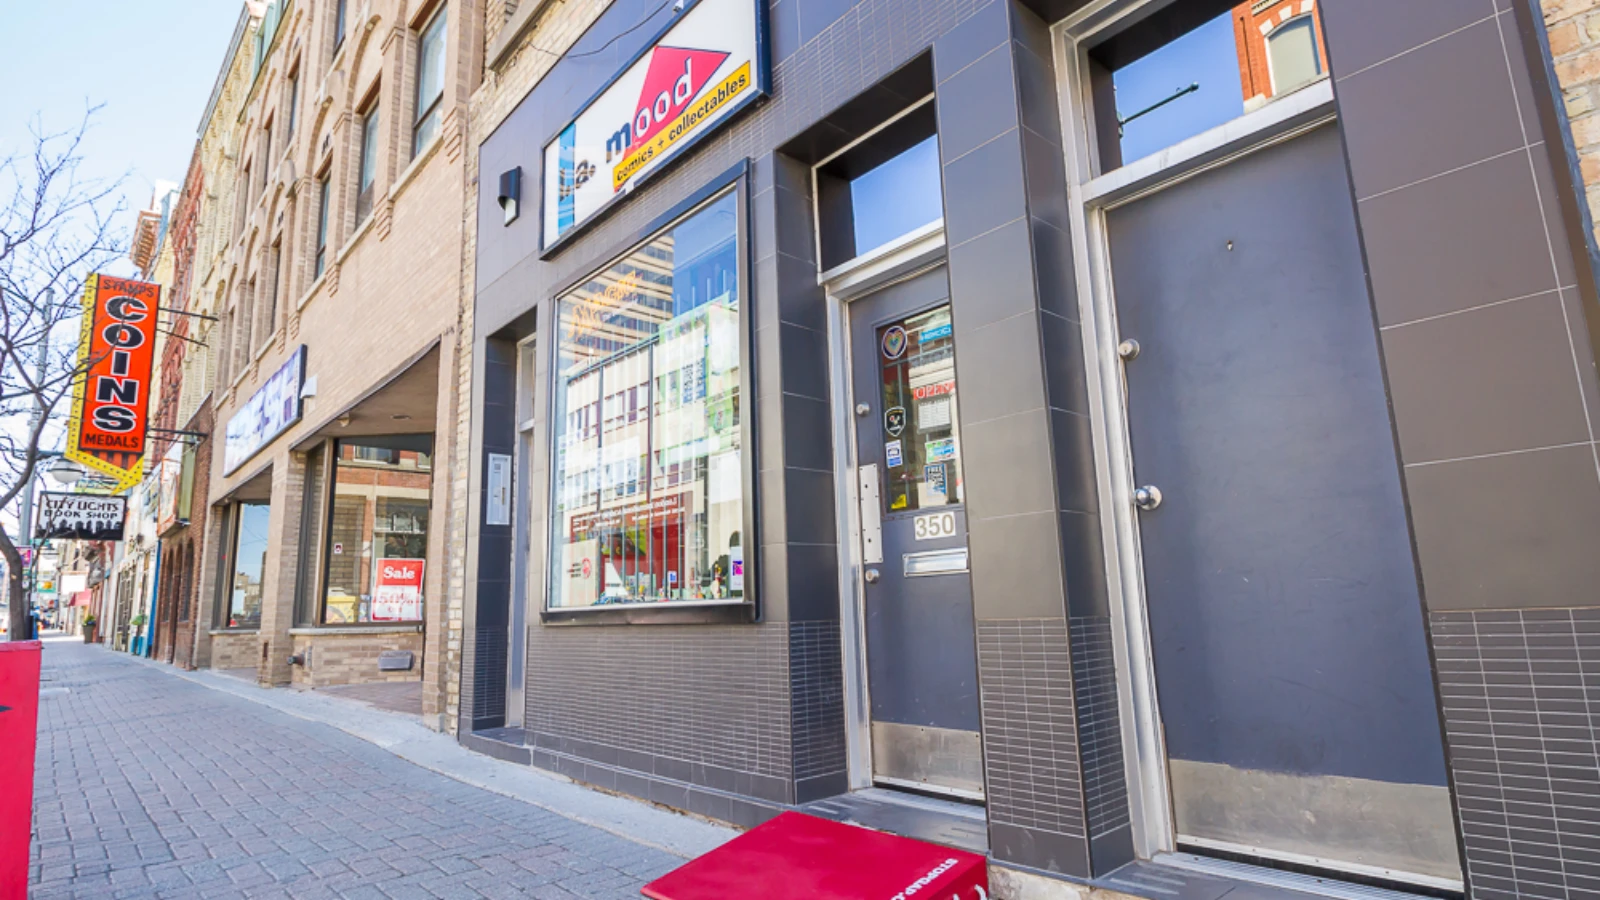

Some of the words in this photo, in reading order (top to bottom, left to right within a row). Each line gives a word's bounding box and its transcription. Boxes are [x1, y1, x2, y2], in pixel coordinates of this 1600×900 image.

[606, 57, 693, 164] mood
[617, 147, 654, 181] comics
[668, 74, 746, 141] collectables
[103, 279, 155, 297] STAMPS
[92, 296, 148, 433] COINS
[916, 381, 953, 400] OPEN
[85, 433, 138, 449] MEDALS
[44, 509, 81, 518] BOOK
[86, 511, 118, 519] SHOP
[46, 499, 74, 509] CITY
[77, 501, 119, 512] LIGHTS
[916, 514, 954, 537] 350
[383, 565, 415, 579] Sale
